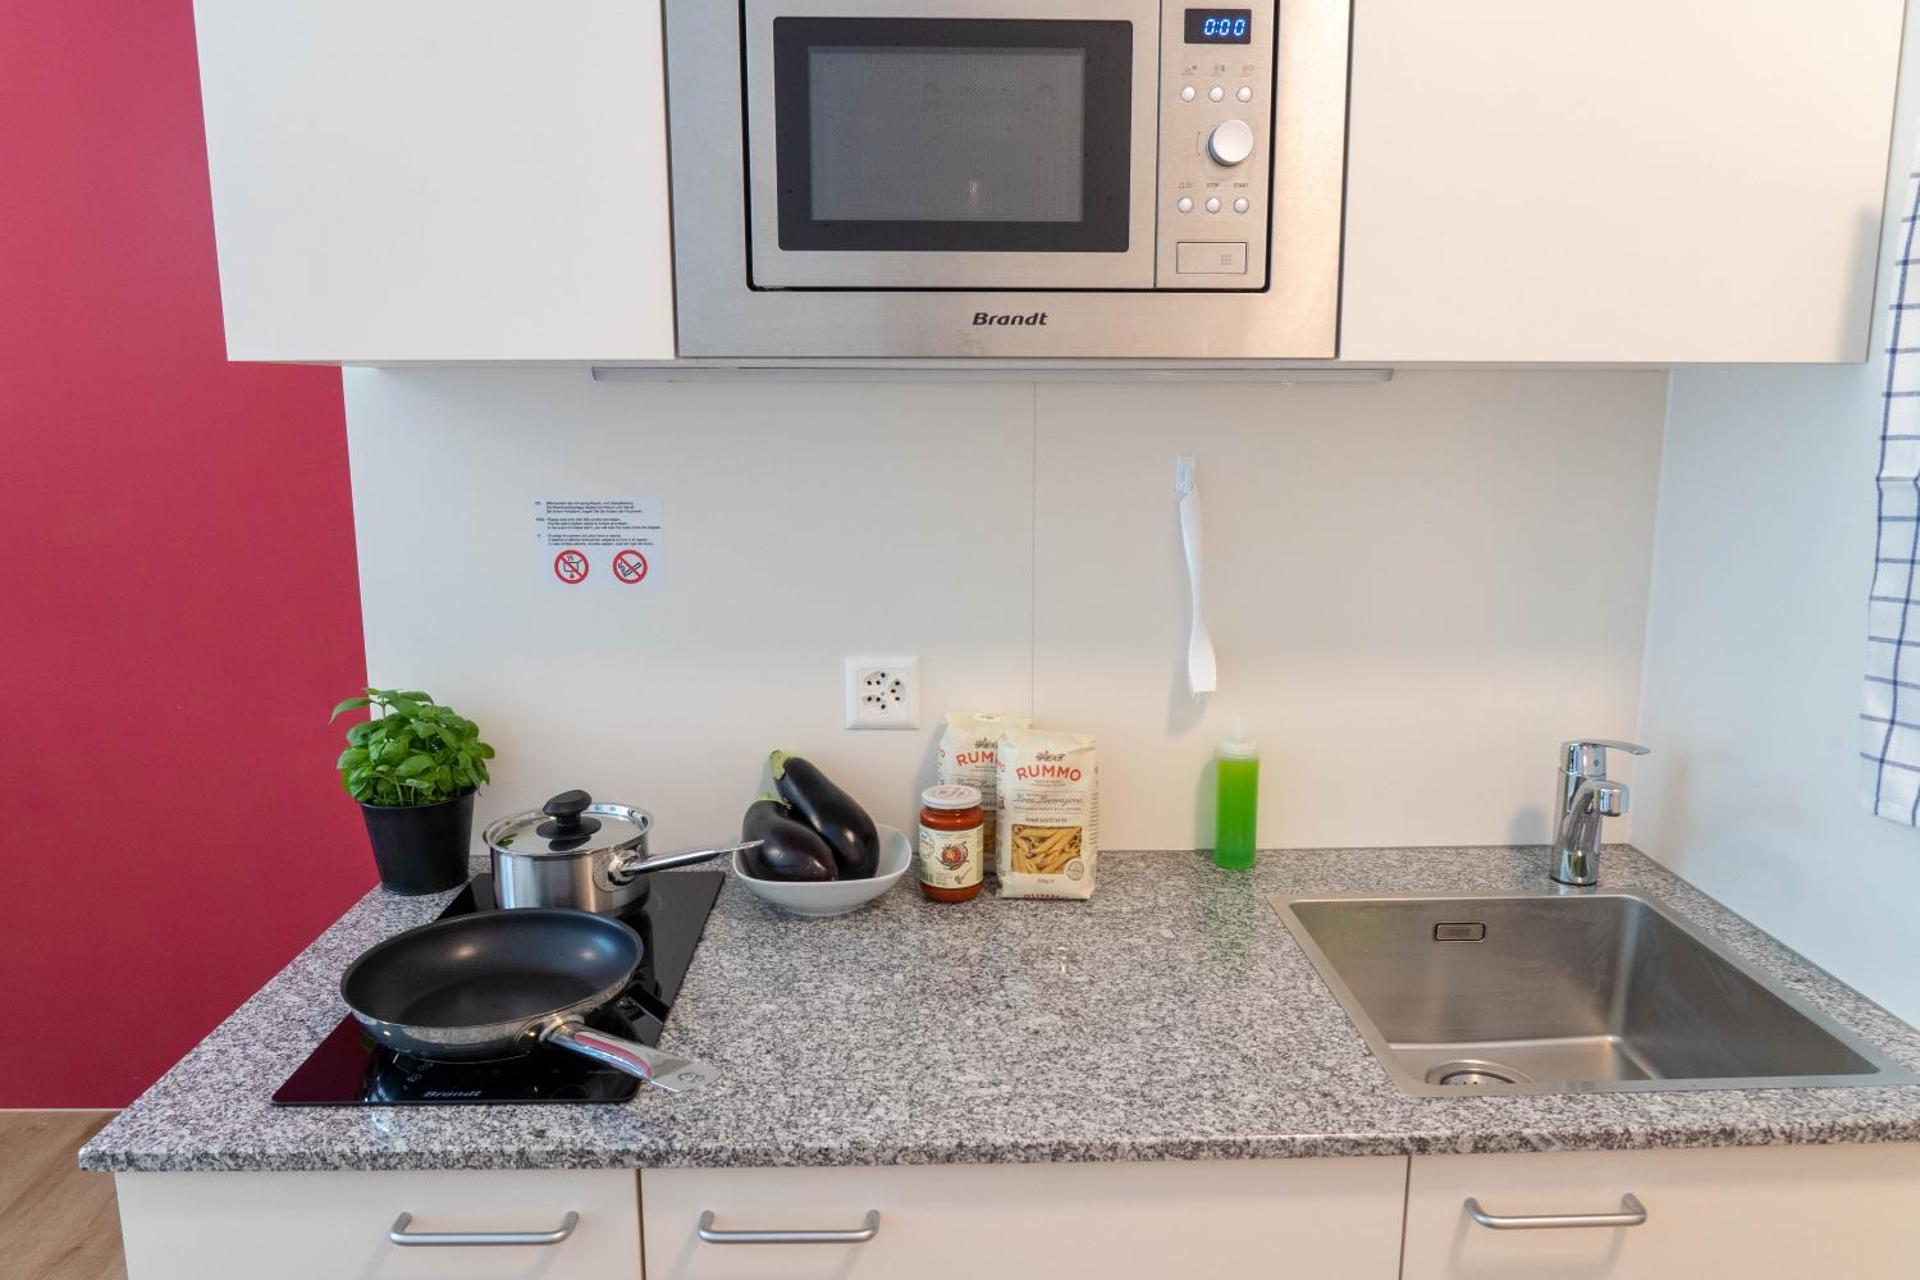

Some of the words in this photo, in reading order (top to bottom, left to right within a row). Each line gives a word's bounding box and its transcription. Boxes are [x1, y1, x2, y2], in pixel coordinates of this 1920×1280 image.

[1204, 18, 1245, 36] 0:00
[972, 311, 1049, 326] Brandt
[956, 751, 998, 766] RUM
[1016, 765, 1082, 782] RUMMO
[422, 1090, 482, 1098] Brandt
